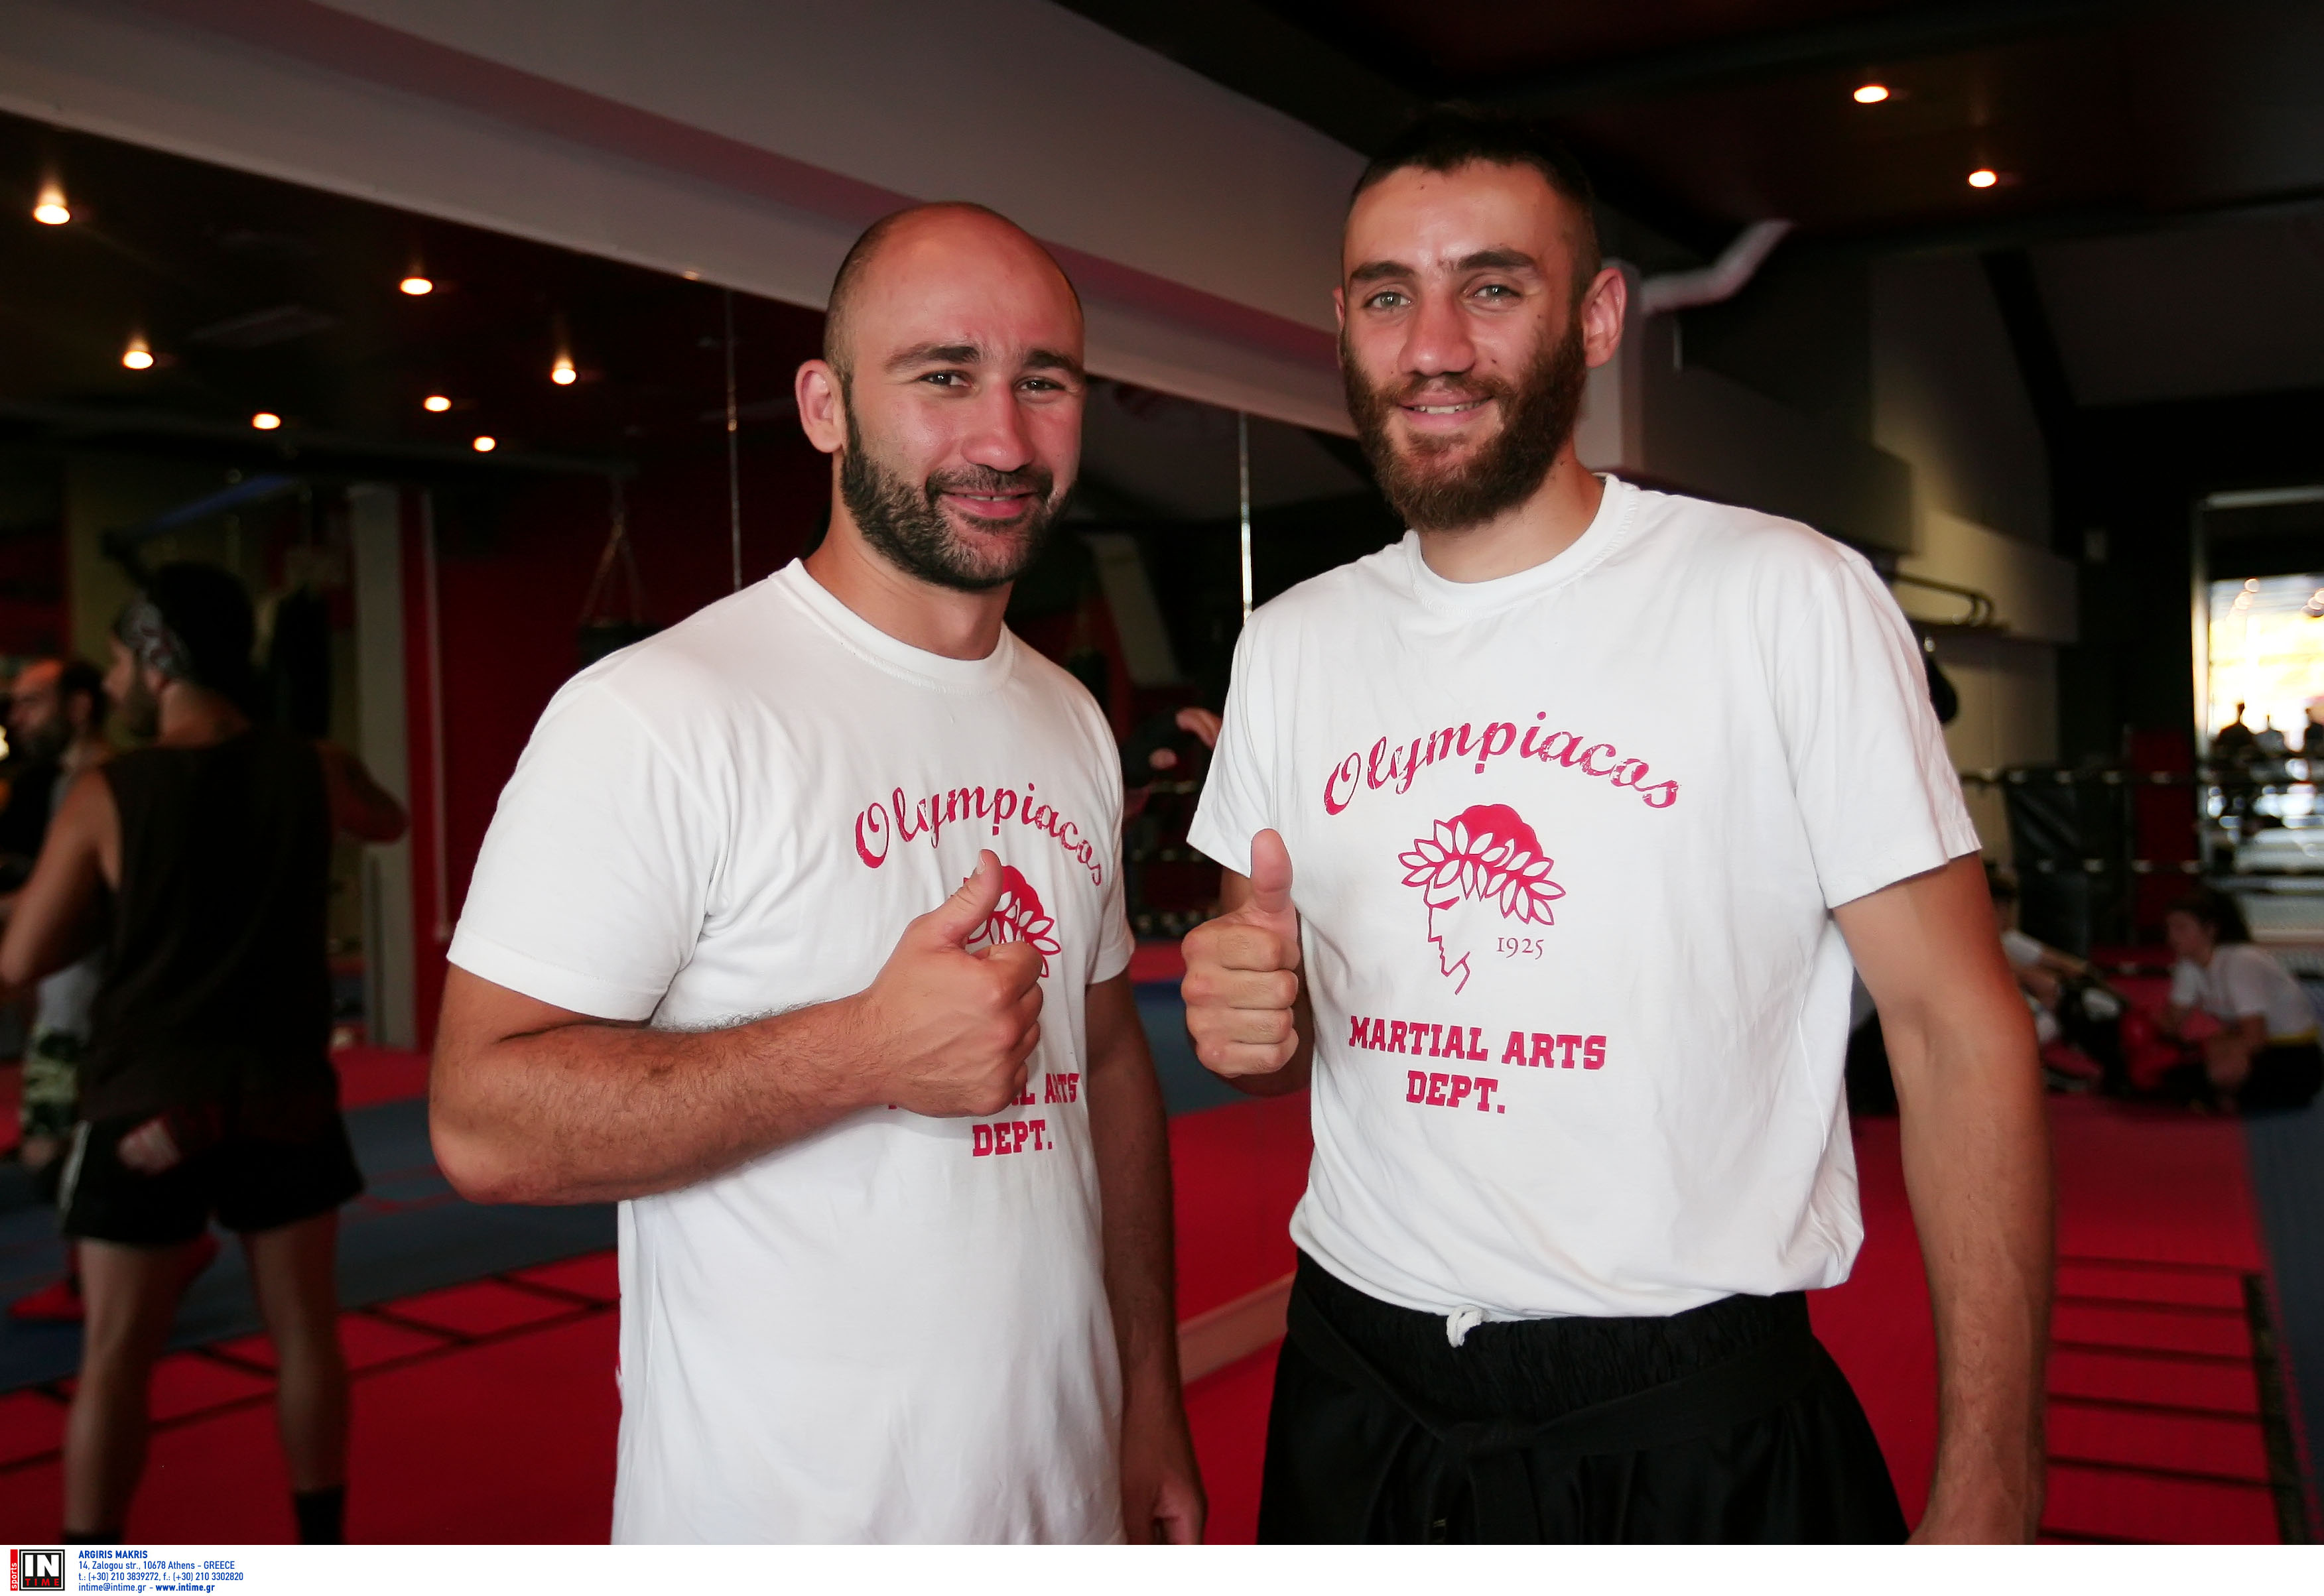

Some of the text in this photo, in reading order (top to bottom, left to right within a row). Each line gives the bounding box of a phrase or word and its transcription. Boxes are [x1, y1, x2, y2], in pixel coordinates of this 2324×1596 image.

[1324, 711, 1681, 816] Olympiacos
[855, 782, 1102, 887] Olympiacos
[1496, 936, 1545, 960] 1925
[1348, 1015, 1607, 1070] MARTIAL ARTS
[1406, 1070, 1506, 1114] DEPT.
[972, 1119, 1053, 1157] DEPT.
